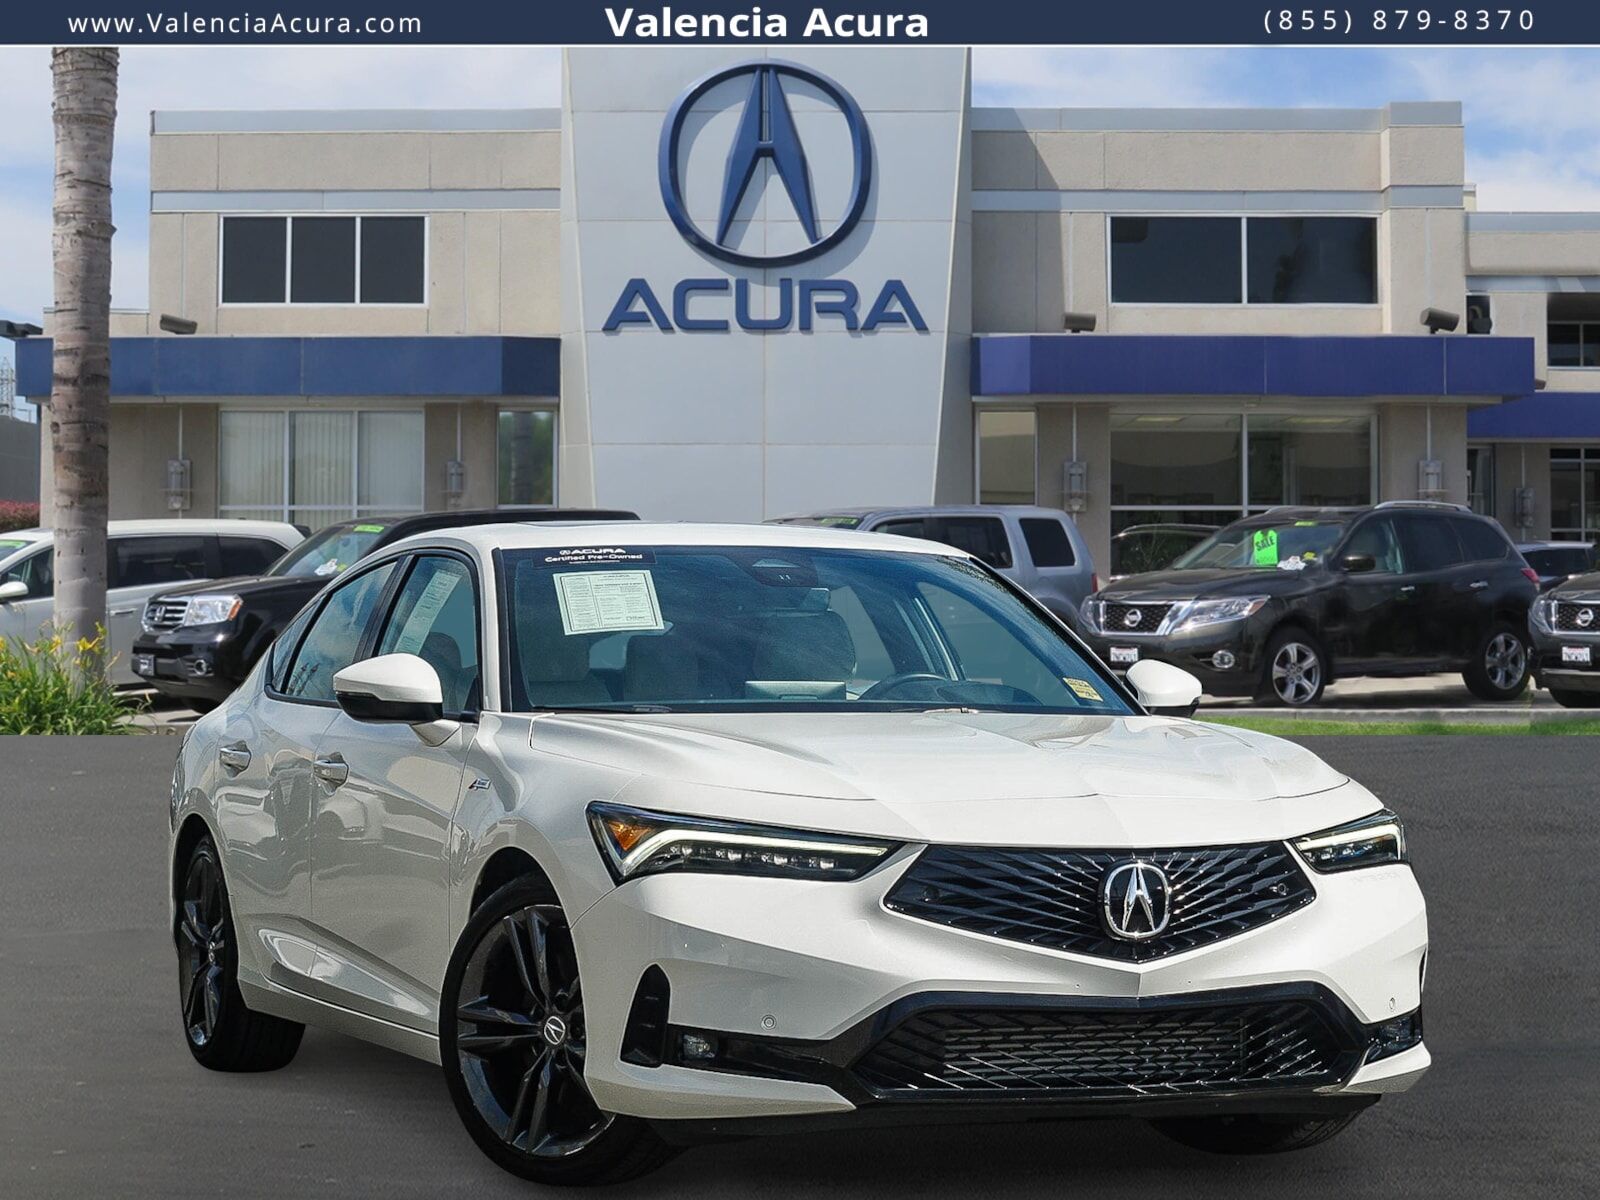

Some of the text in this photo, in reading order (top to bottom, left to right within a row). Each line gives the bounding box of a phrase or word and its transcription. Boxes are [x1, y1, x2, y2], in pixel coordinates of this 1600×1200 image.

[603, 278, 929, 331] ACURA
[1255, 536, 1275, 551] SALE
[544, 554, 586, 562] Certified
